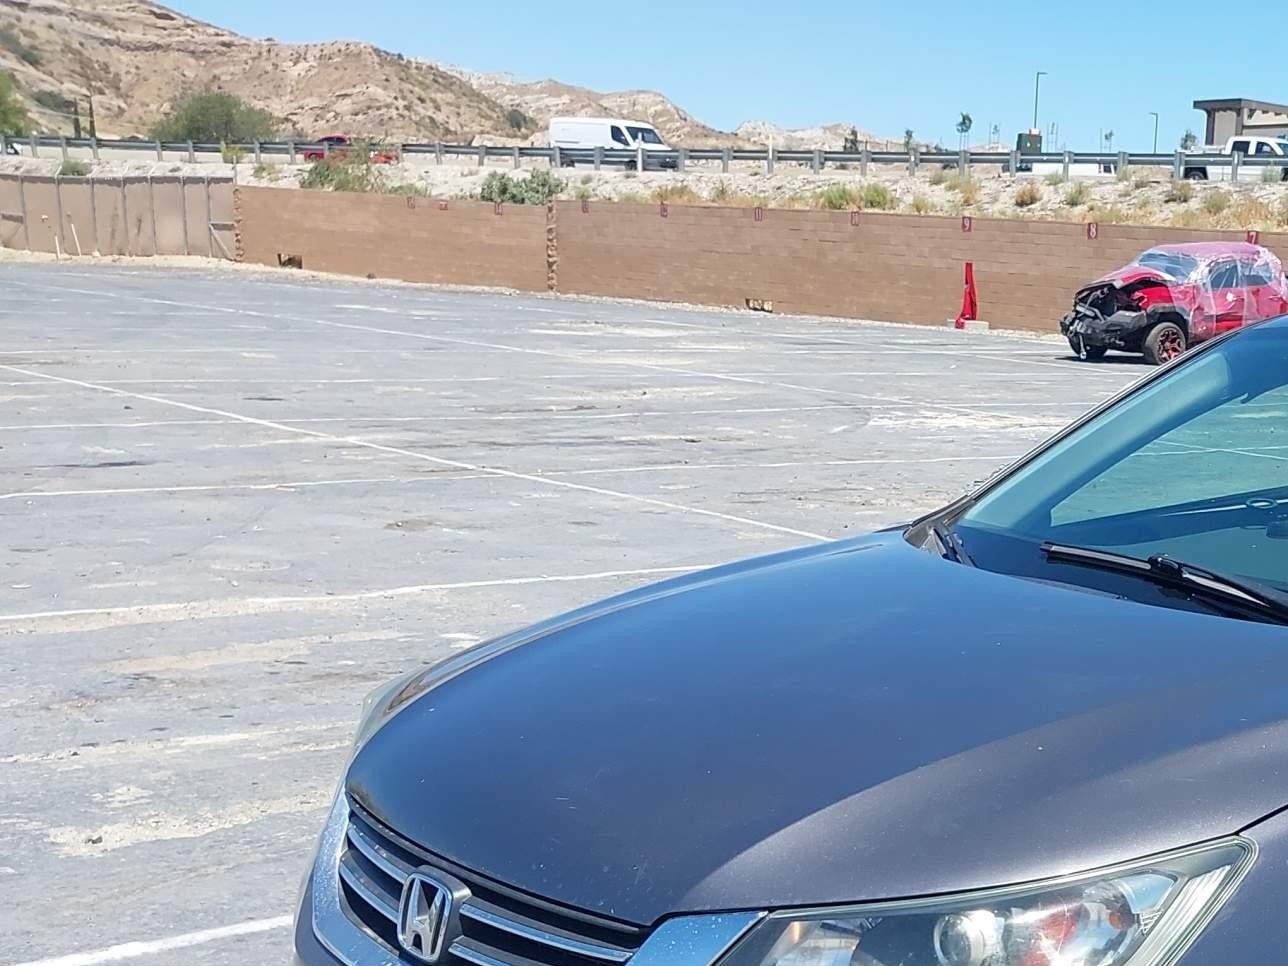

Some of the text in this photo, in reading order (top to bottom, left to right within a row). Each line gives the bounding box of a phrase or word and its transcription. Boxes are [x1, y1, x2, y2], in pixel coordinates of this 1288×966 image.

[963, 218, 970, 230] 9
[1089, 223, 1097, 238] 8
[1249, 231, 1256, 244] 7
